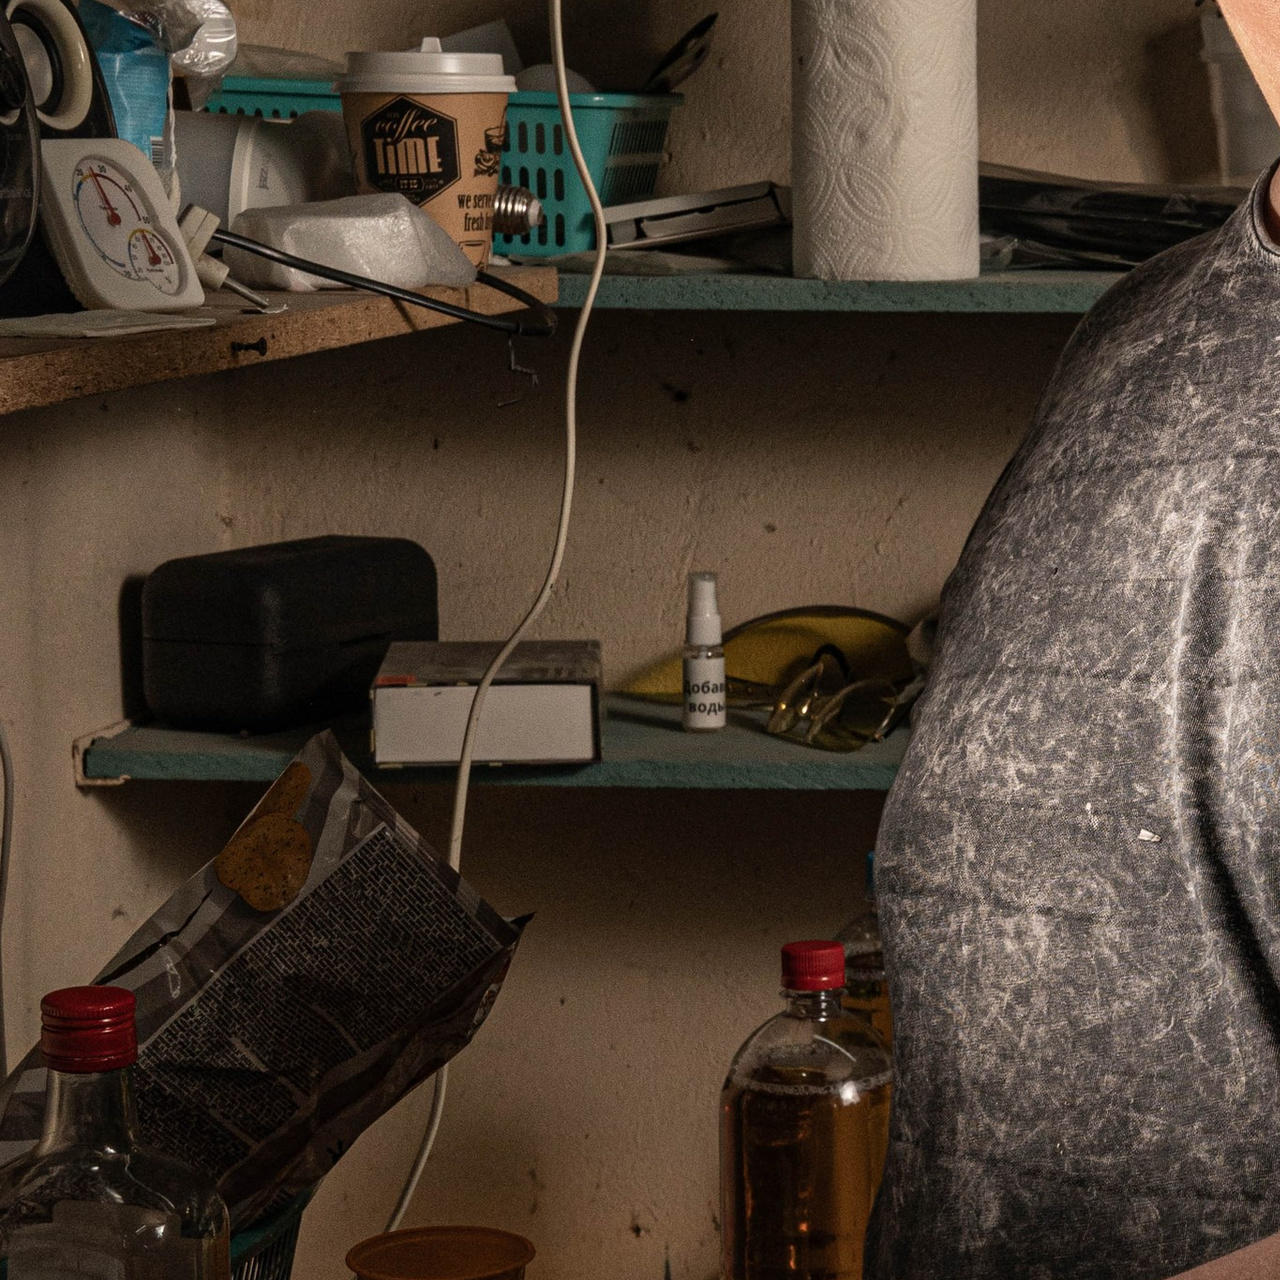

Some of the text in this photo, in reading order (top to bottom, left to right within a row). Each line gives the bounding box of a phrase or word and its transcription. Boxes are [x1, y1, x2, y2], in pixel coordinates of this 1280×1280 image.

[375, 108, 438, 141] coffee
[458, 194, 472, 209] we
[464, 212, 485, 232] fresh
